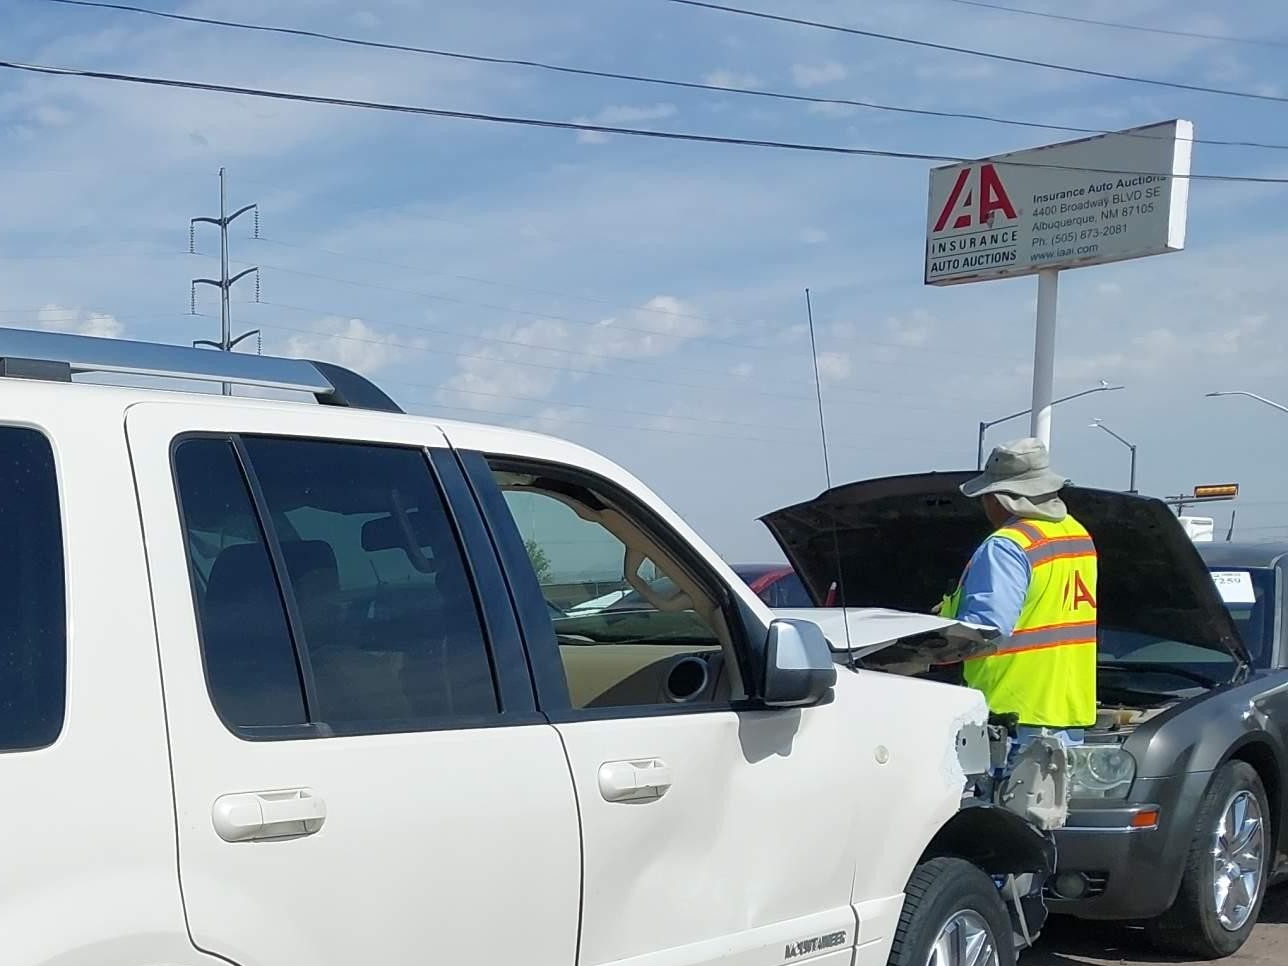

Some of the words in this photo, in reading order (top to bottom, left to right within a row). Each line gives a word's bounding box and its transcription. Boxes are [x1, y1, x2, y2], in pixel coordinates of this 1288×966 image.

[1032, 206, 1057, 217] 4400
[1060, 197, 1109, 213] Broadway
[1112, 190, 1142, 204] BLVD
[1146, 186, 1161, 199] SE
[1033, 188, 1085, 203] Insurance
[1088, 182, 1113, 193] Auto
[1101, 209, 1119, 220] NM
[1122, 203, 1154, 217] 87105
[932, 231, 1018, 254] INSURANCE
[1051, 232, 1078, 246] (505)
[1080, 224, 1127, 240] 873-2081
[931, 258, 960, 273] AUTO
[962, 249, 1017, 268] AUCTIONS
